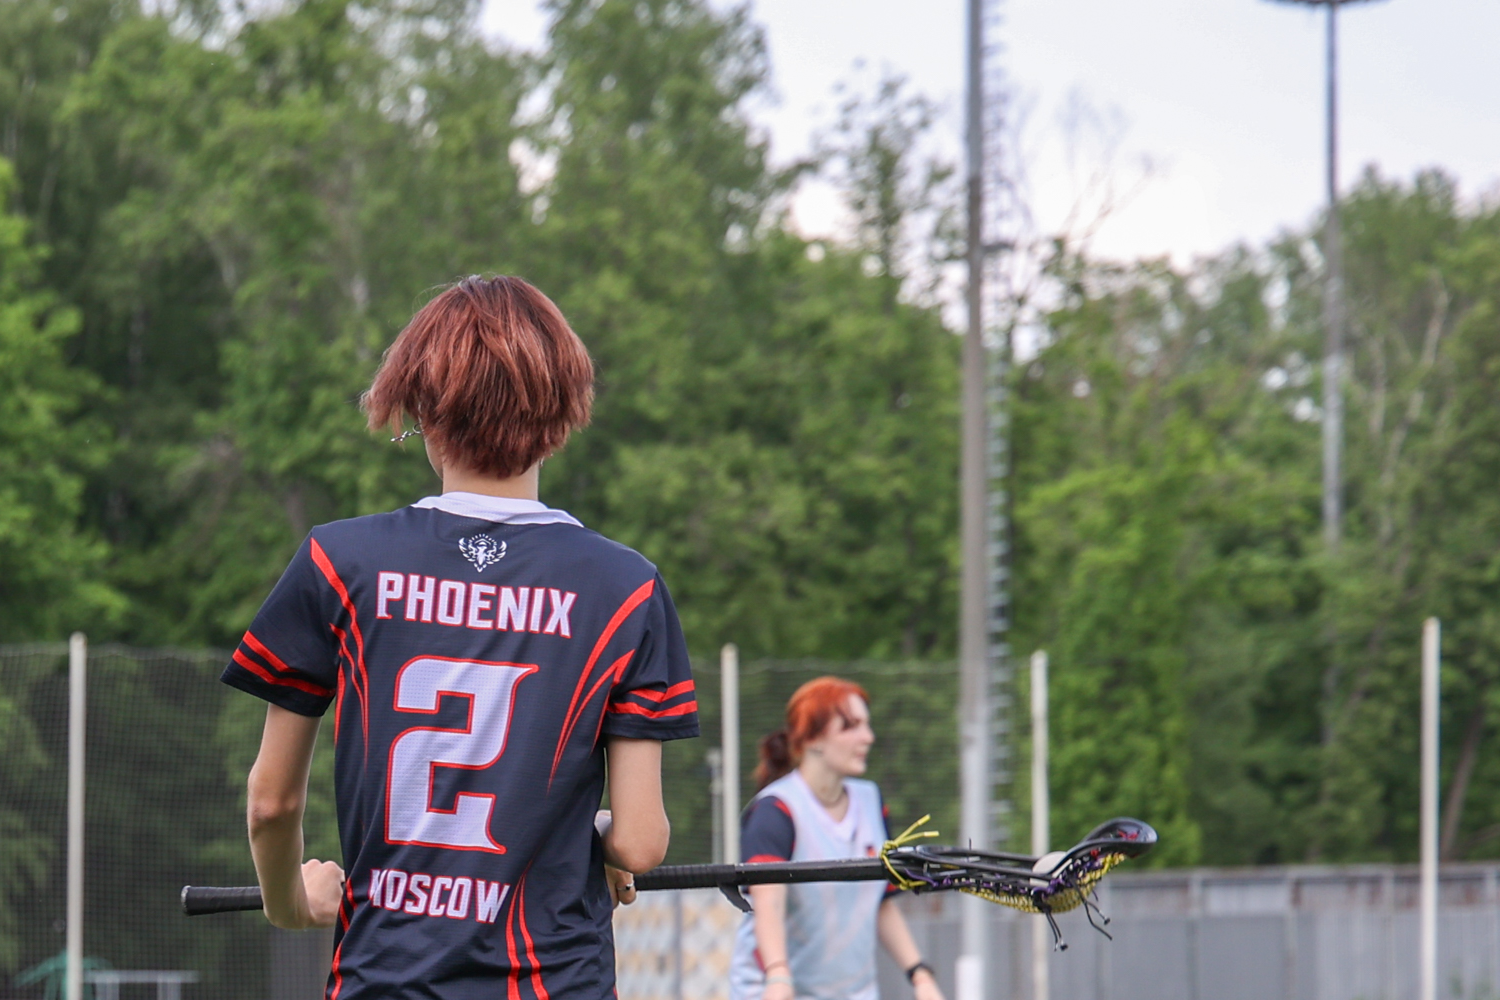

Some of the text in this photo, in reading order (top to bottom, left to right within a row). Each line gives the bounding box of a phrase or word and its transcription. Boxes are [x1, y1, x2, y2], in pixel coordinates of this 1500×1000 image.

[376, 571, 578, 639] PHOENIX
[384, 654, 540, 855] 2
[368, 868, 511, 924] MOSCOW
